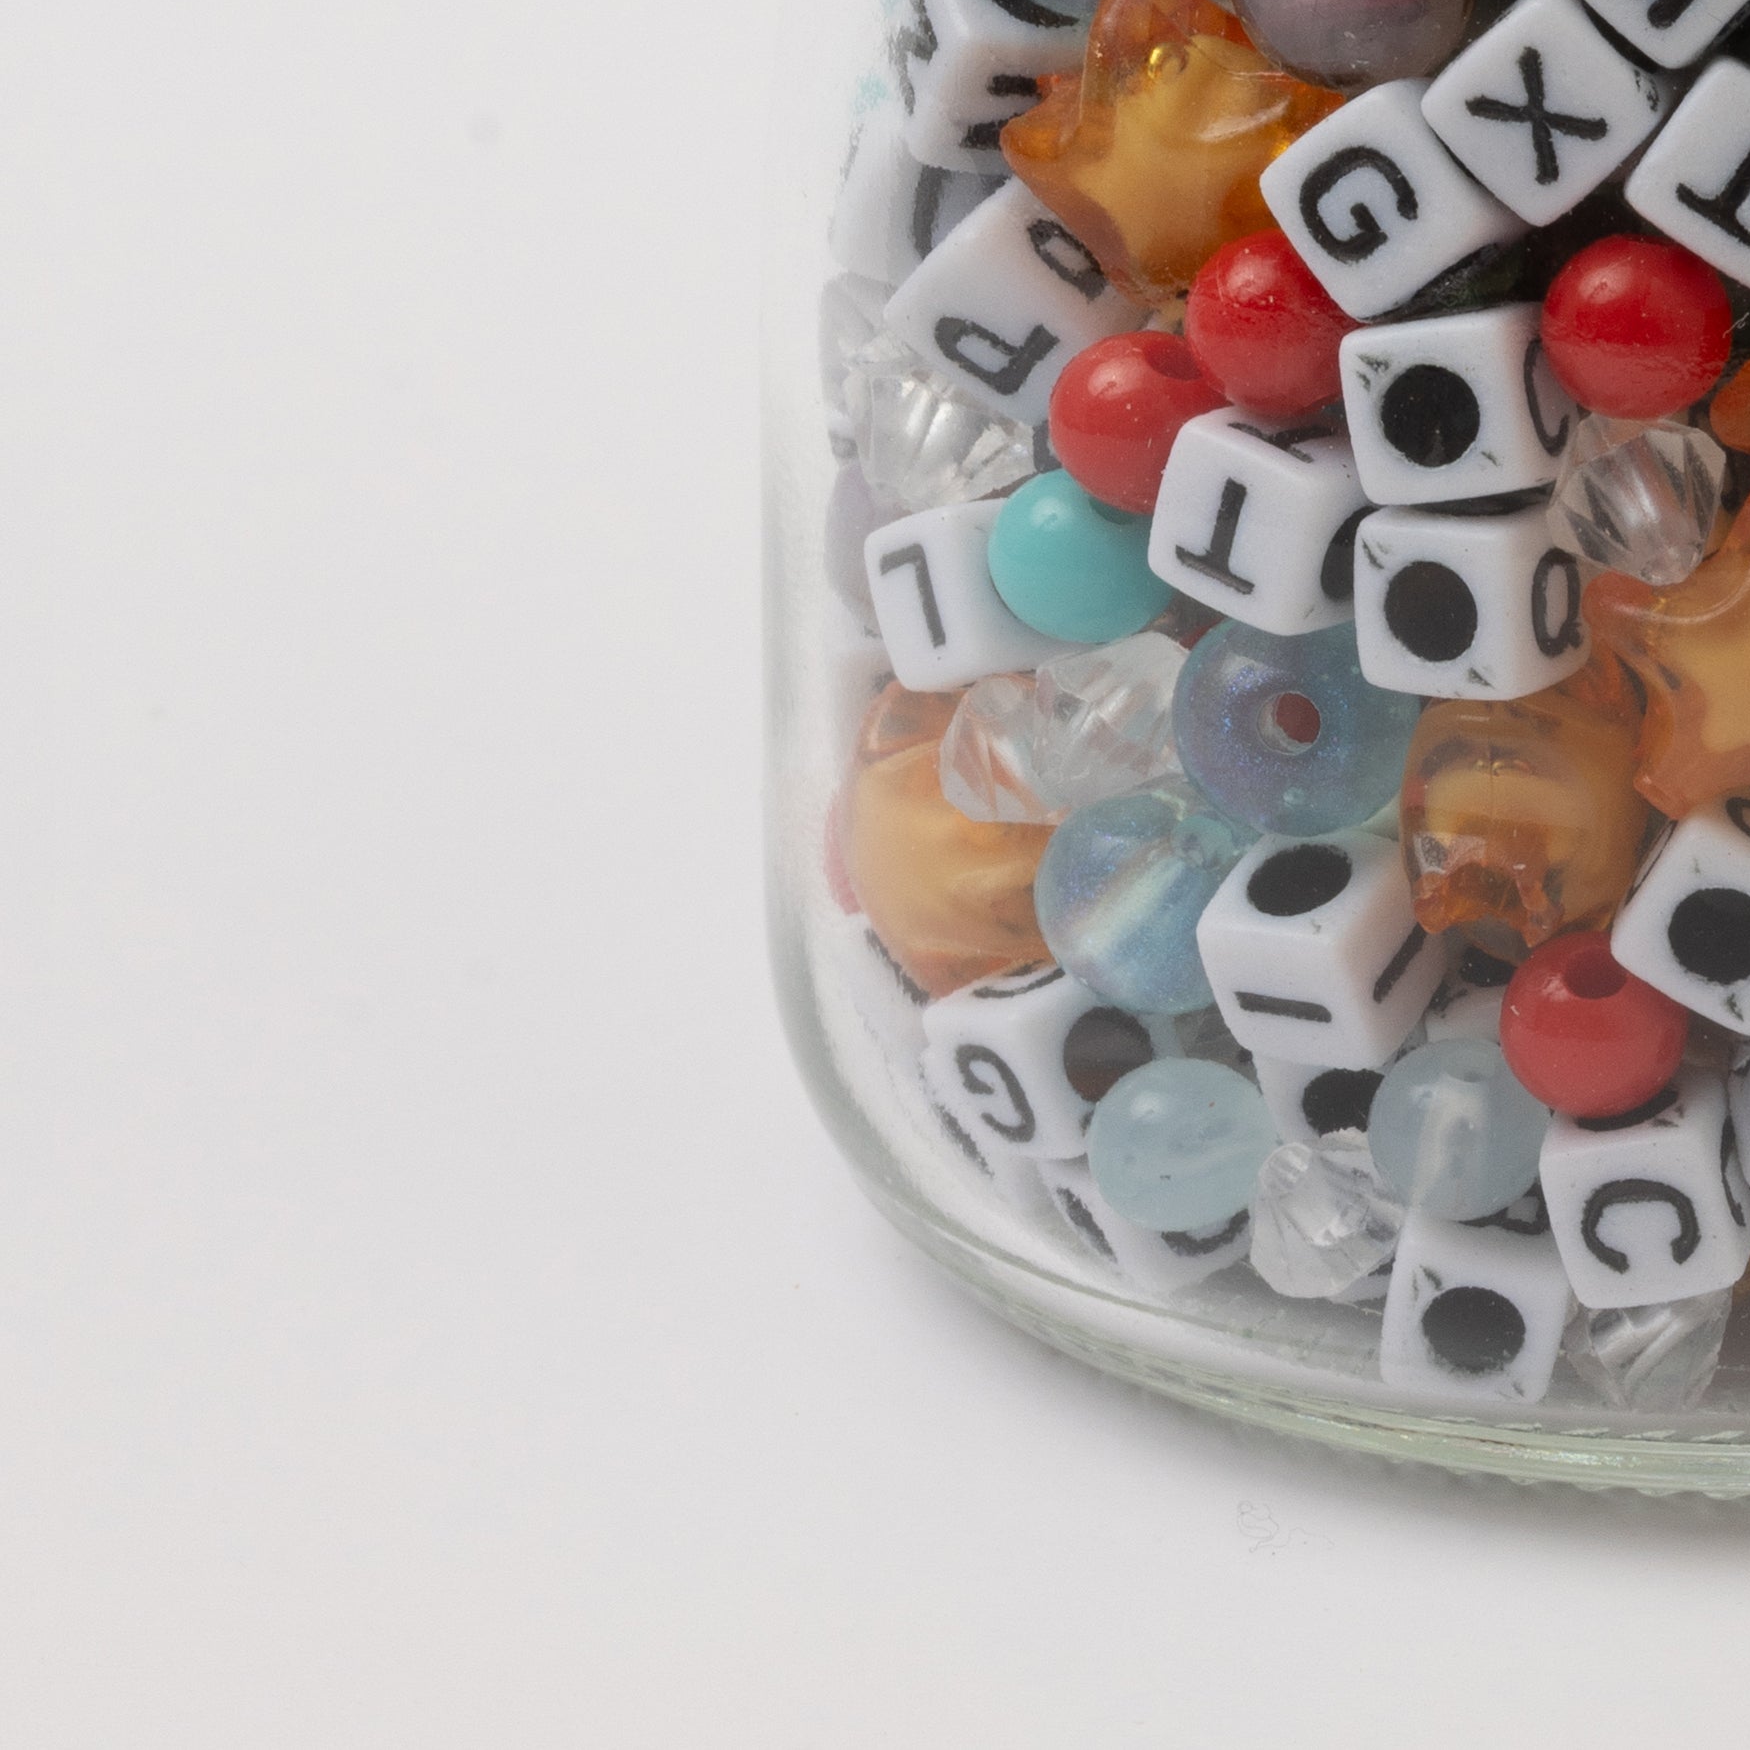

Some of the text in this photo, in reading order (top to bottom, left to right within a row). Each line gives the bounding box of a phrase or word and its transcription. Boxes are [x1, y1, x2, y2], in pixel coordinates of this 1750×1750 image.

[1465, 46, 1608, 186] X
[1299, 145, 1419, 265] G
[1174, 476, 1256, 597] T
[1530, 547, 1583, 658] Q
[1580, 1177, 1701, 1275] C
